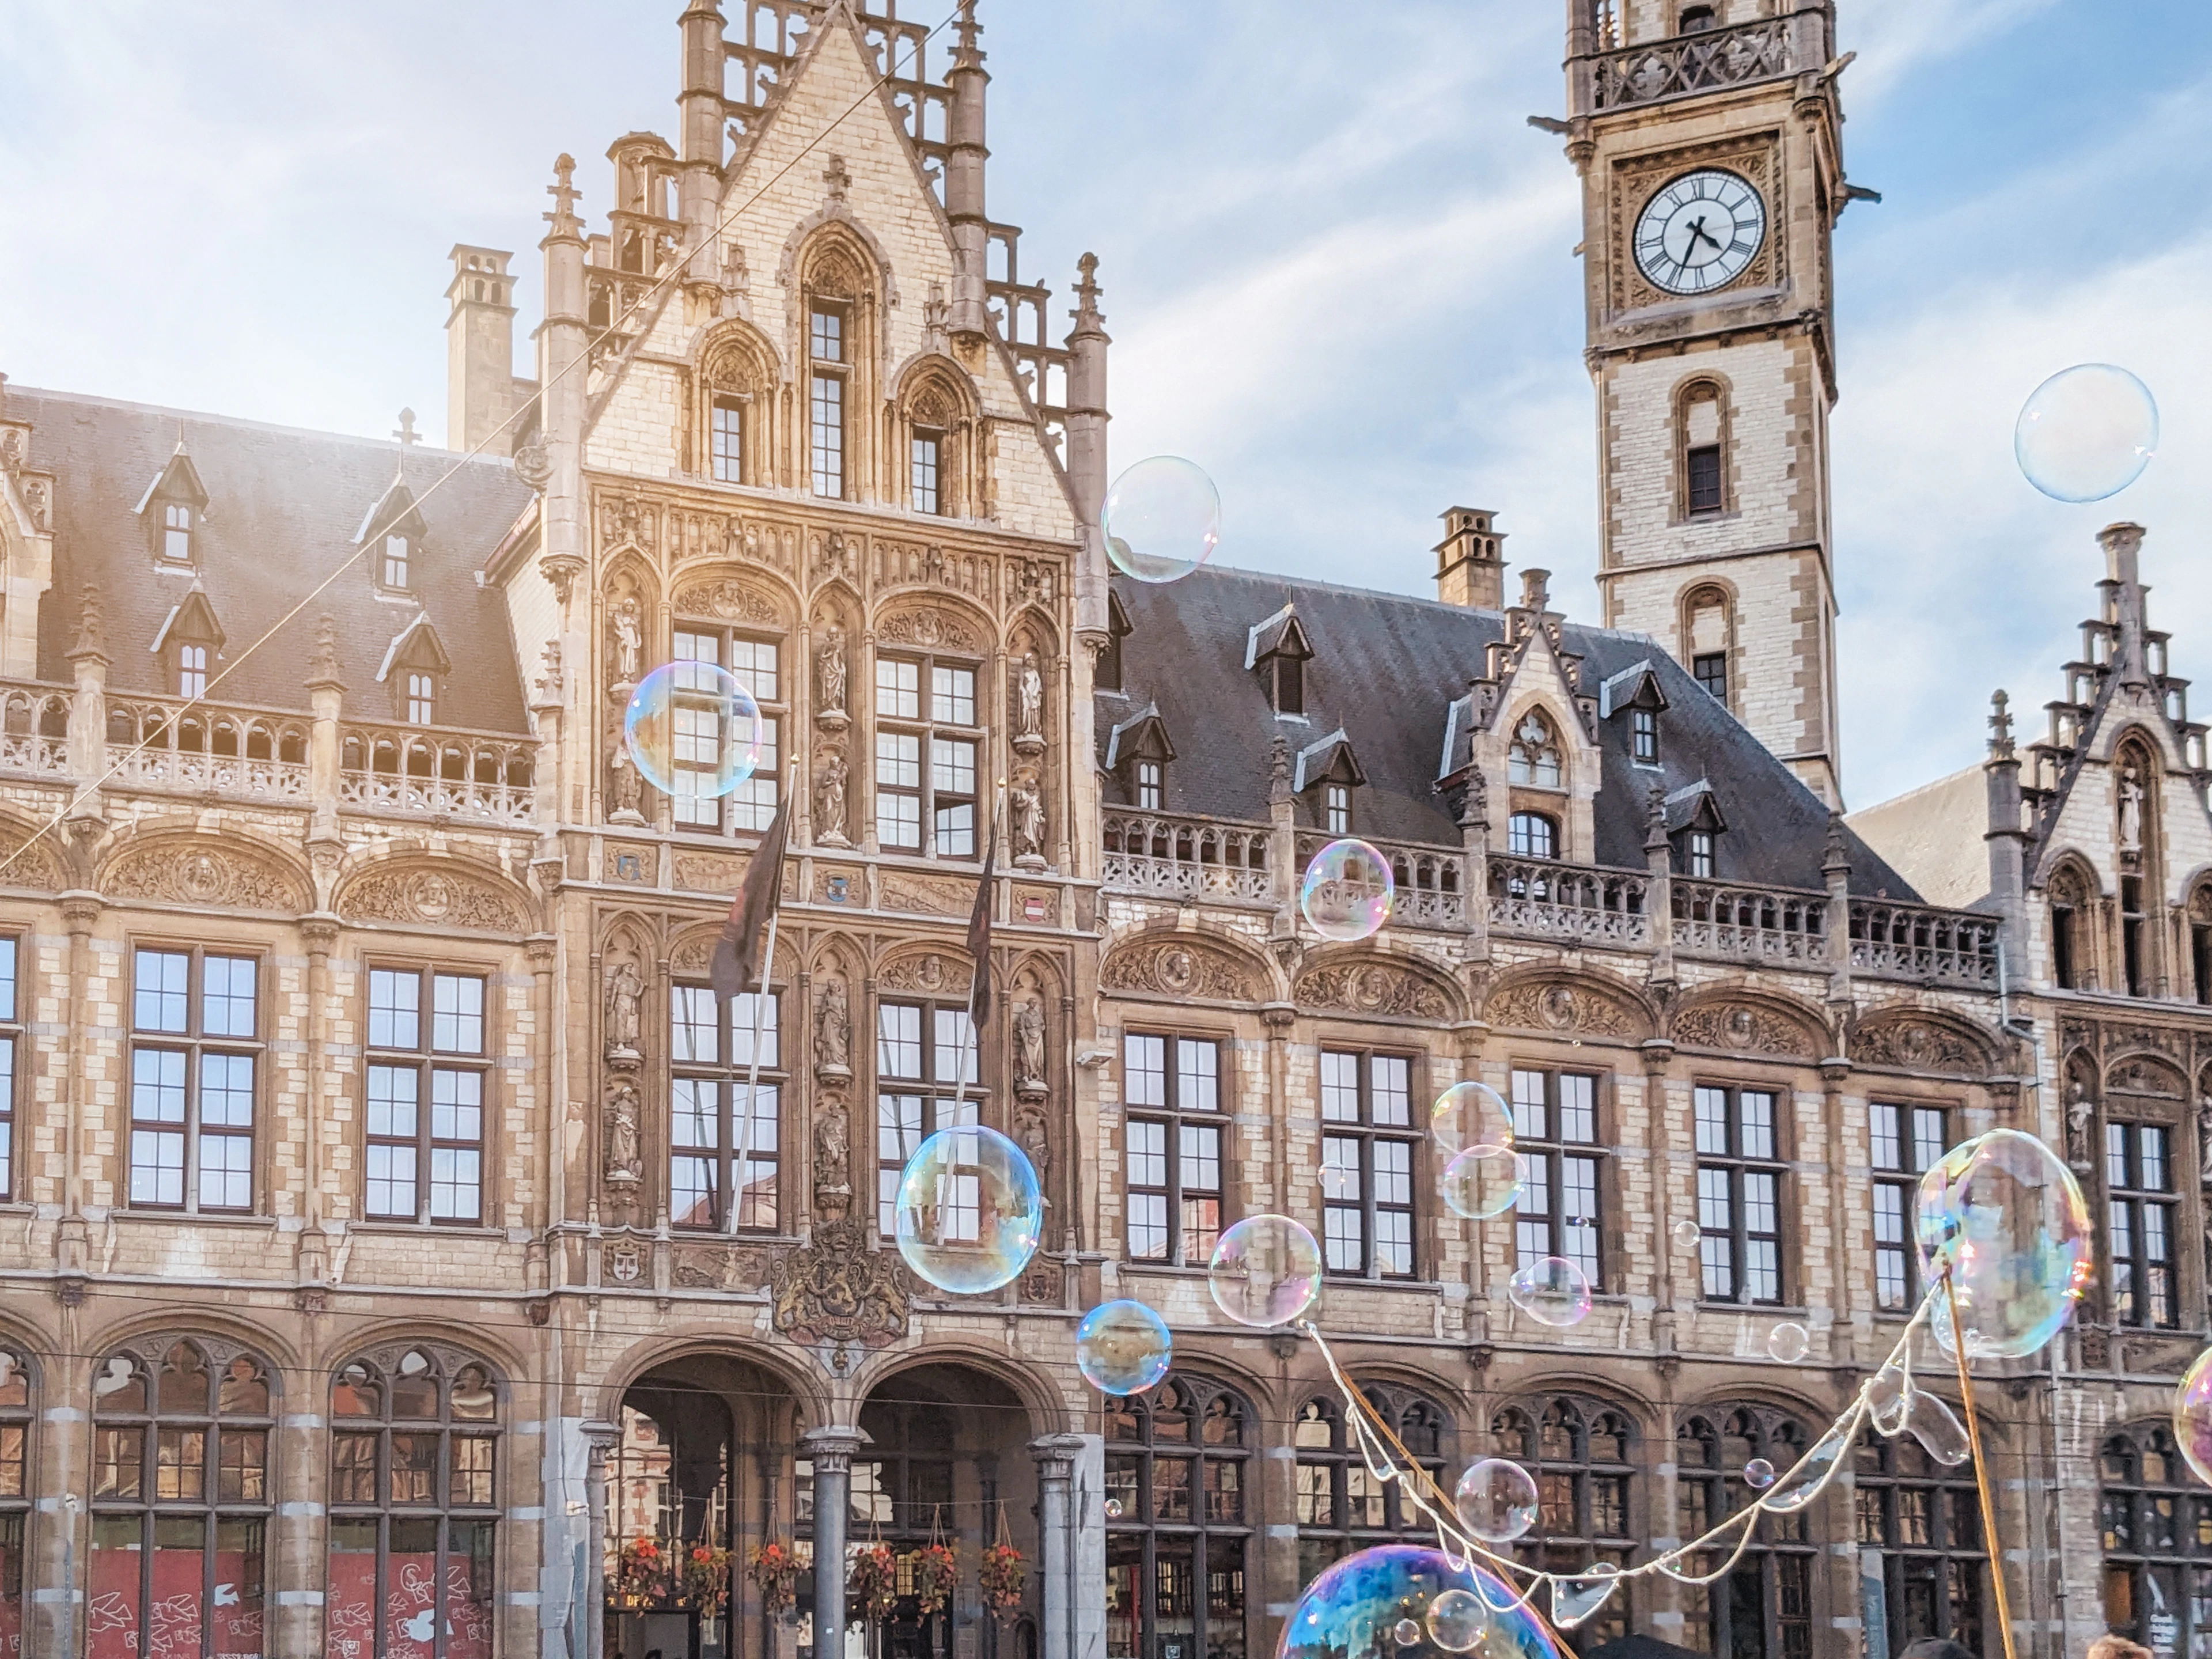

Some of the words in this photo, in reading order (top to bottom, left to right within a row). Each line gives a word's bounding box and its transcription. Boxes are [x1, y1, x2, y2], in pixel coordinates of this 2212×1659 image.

[1691, 177, 1704, 199] XII
[1716, 180, 1728, 200] I
[1665, 190, 1683, 210] XI
[1729, 195, 1750, 211] II
[1647, 214, 1666, 224] X
[1736, 219, 1758, 230] III
[1641, 236, 1662, 248] IX
[1729, 240, 1752, 256] IIII
[1645, 251, 1669, 275] VIII
[1718, 259, 1732, 275] V
[1694, 267, 1706, 287] VI
